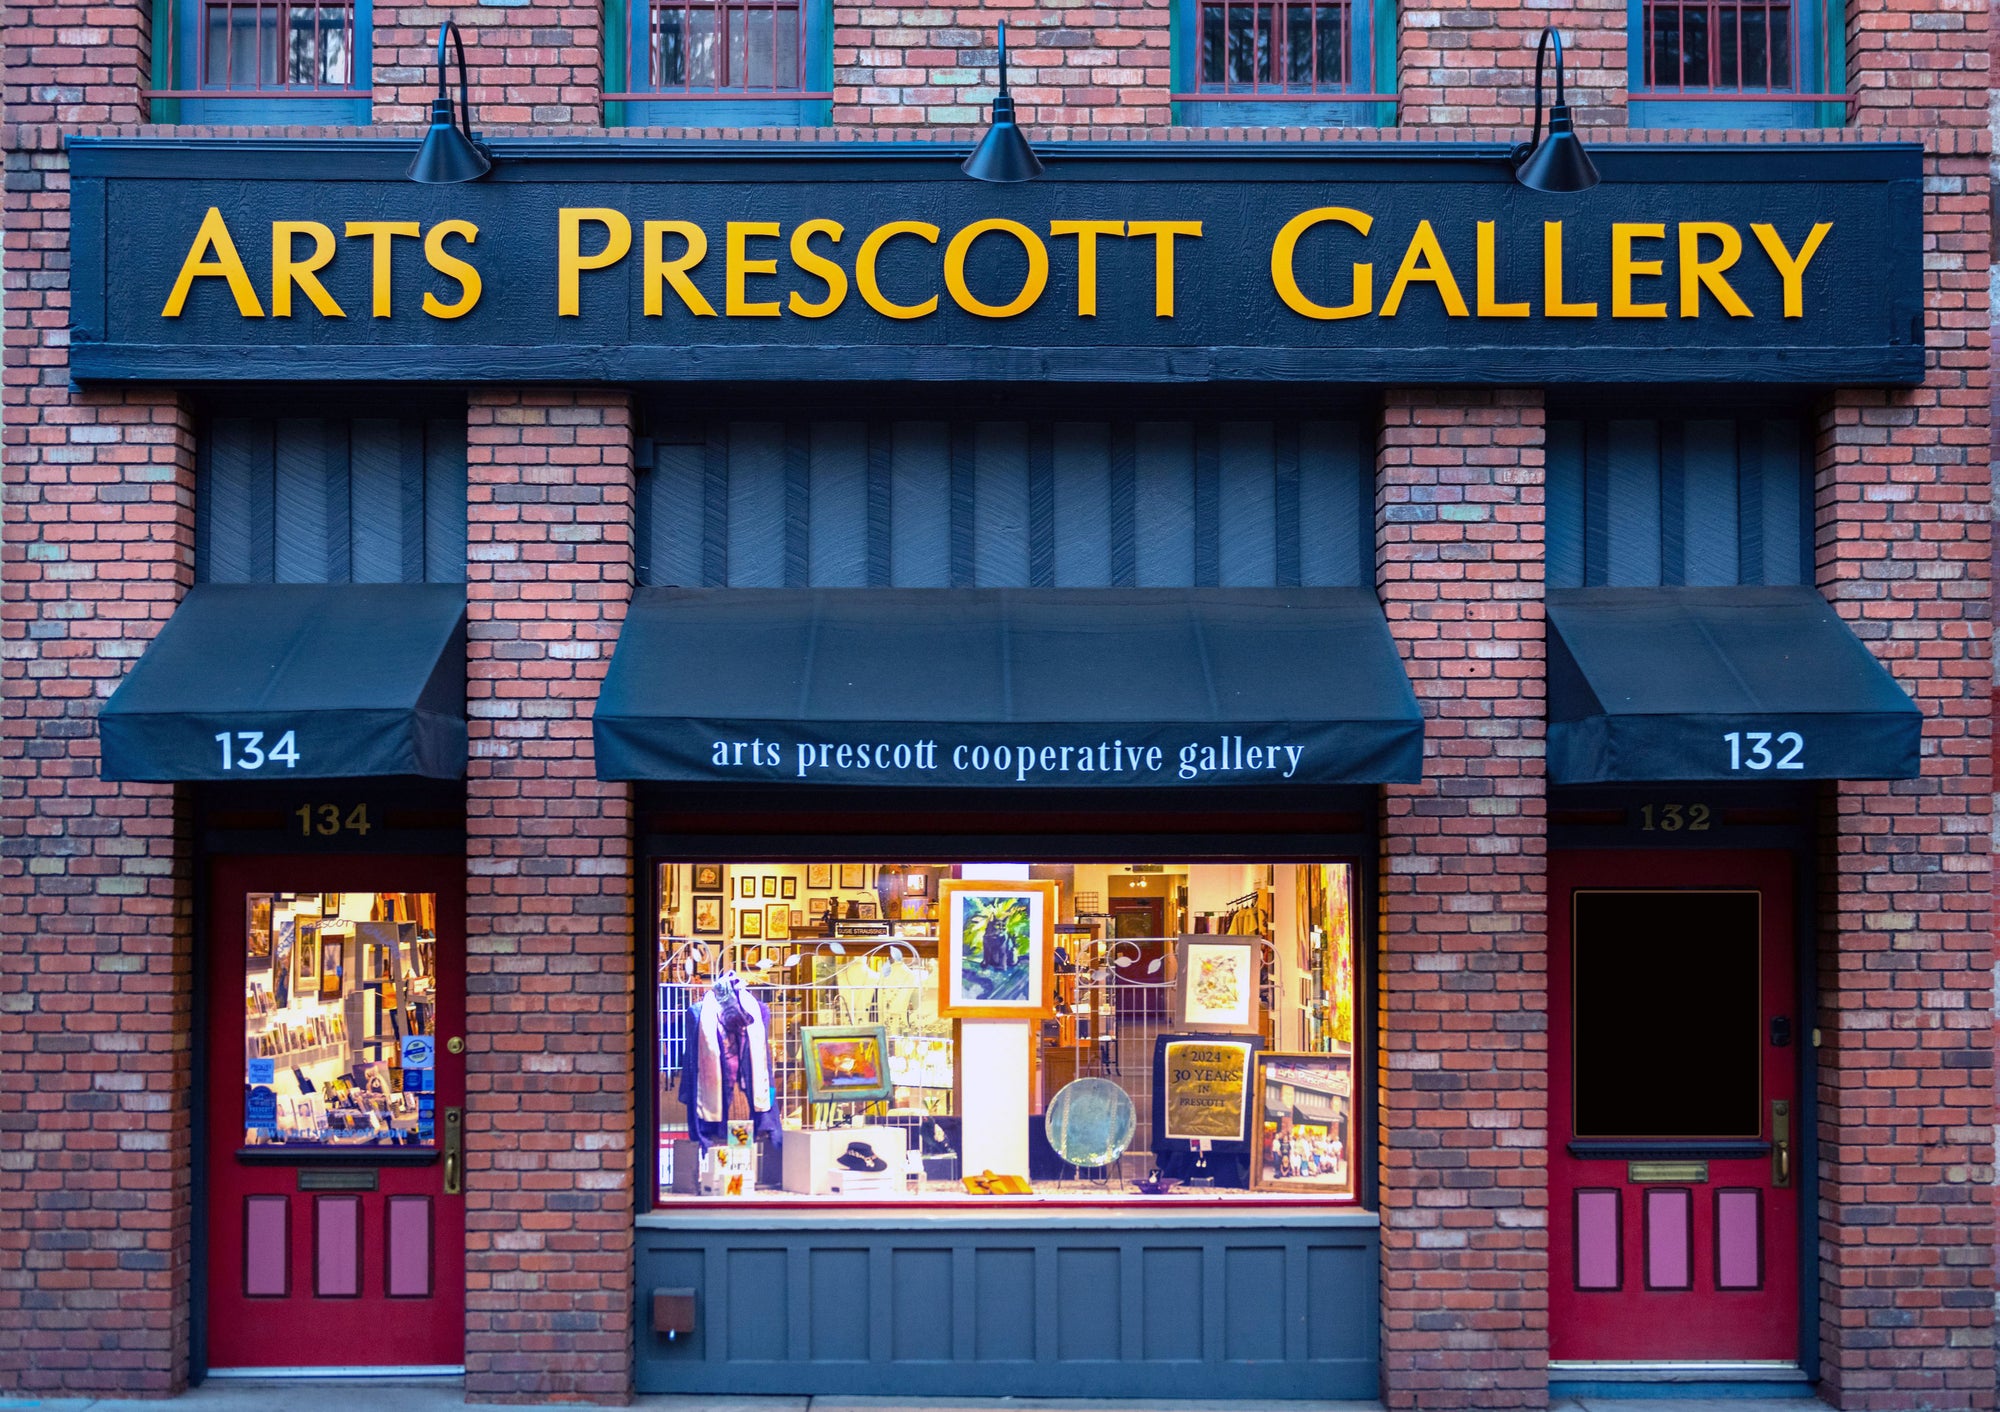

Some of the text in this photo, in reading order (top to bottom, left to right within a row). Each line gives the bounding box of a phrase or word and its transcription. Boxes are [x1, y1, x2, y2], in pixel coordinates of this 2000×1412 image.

[162, 206, 1834, 319] ARTS PRESCOTT GALLERY
[215, 730, 300, 770] 134
[712, 735, 1305, 781] arts prescott cooperative gallery
[1724, 730, 1804, 770] 132
[296, 803, 371, 836] 134
[1640, 803, 1710, 831] 132
[1191, 1050, 1221, 1062] 2024
[1172, 1069, 1239, 1084] 30 YEARS
[1198, 1085, 1210, 1094] IN
[1180, 1098, 1225, 1108] PRESCOTT
